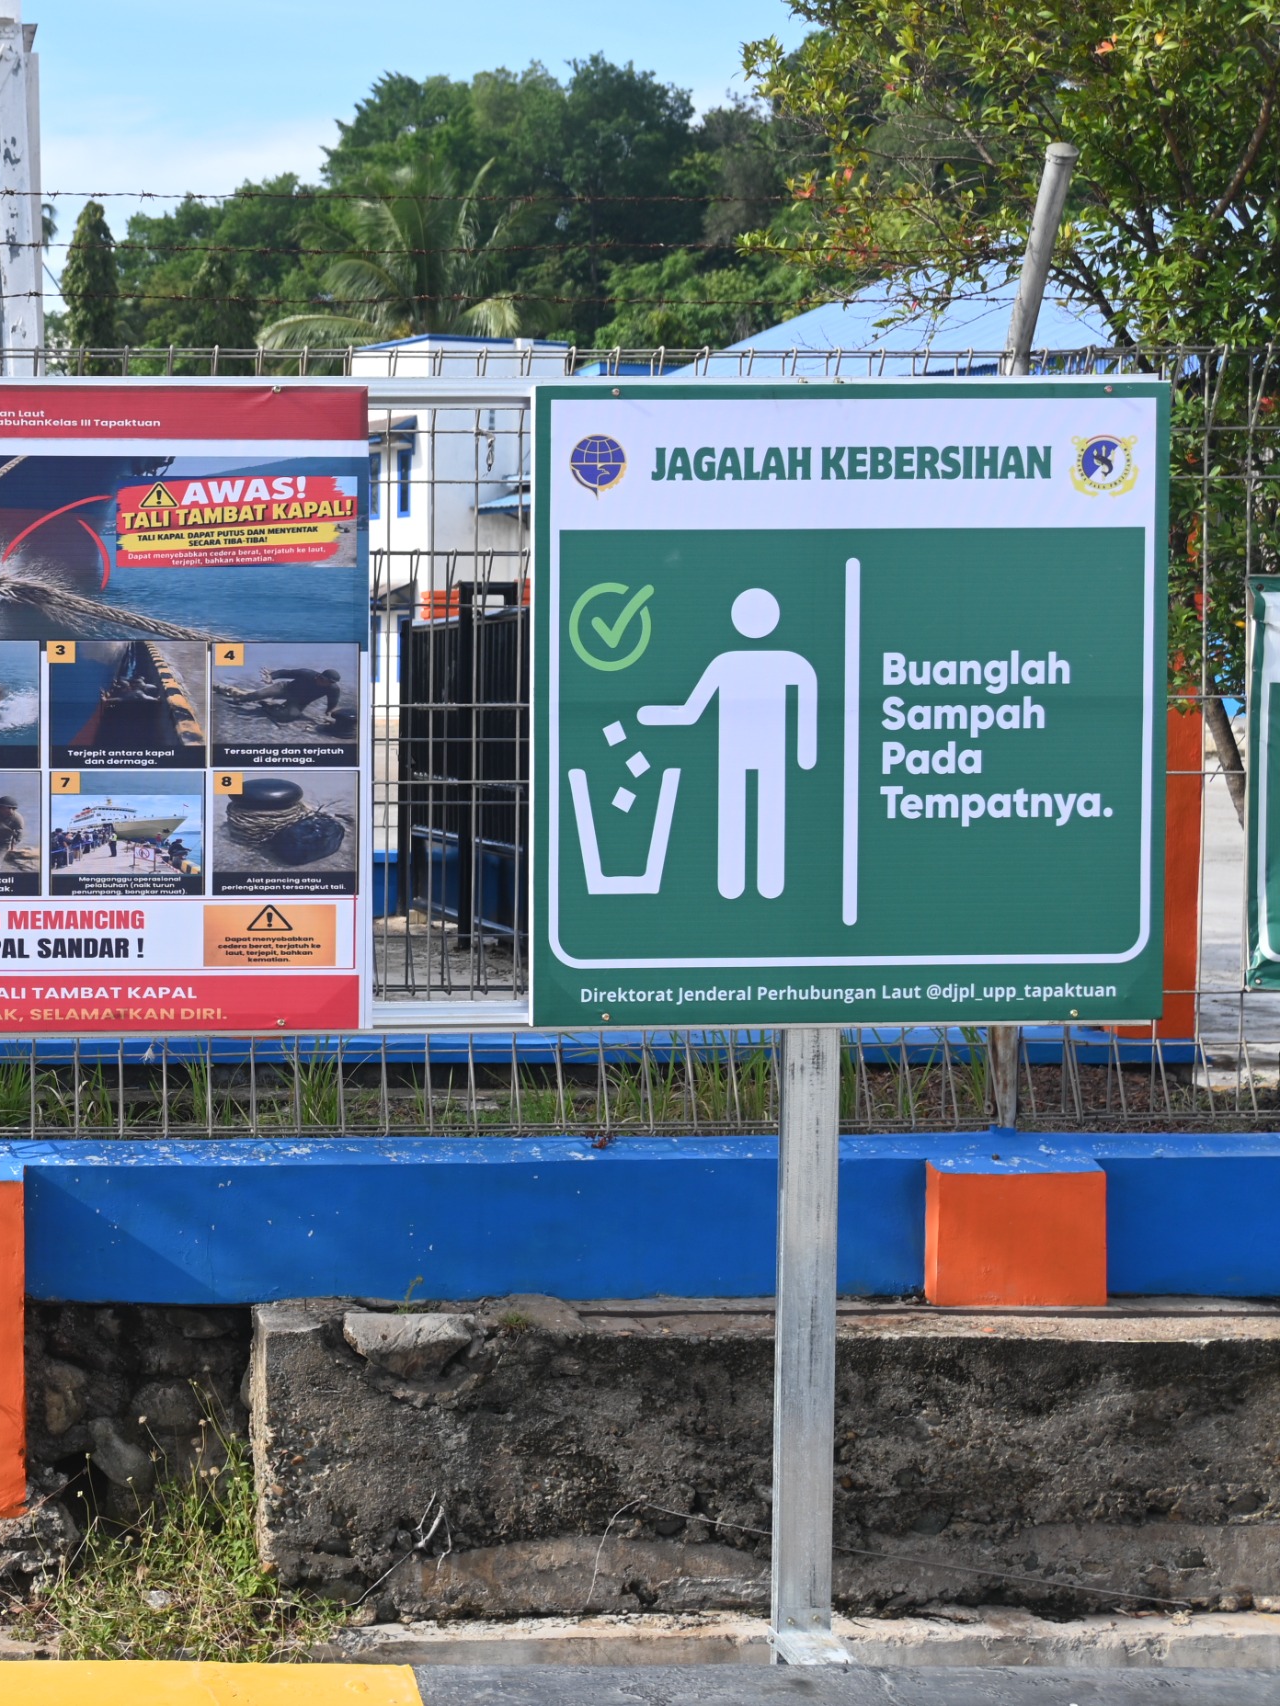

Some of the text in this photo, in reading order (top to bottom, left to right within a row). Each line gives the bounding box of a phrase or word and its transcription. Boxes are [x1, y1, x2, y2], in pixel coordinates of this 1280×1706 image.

[18, 410, 45, 418] Laut
[93, 419, 161, 429] Tapaktuan
[651, 446, 812, 481] JAGALAH
[820, 445, 1052, 480] KEBERSIHAN
[181, 476, 306, 506] AWAS!
[122, 499, 354, 529] TALI TAMBAT KAPAL!
[137, 526, 318, 542] TALI KAPAL DAPAT PUTUS DAN MENYENTAK
[188, 536, 268, 547] SECARA TIBA-TIBA!
[55, 645, 66, 656] 3
[224, 650, 236, 661] 4
[882, 650, 1071, 694] Buanglah
[881, 696, 1045, 738] Sampah
[67, 749, 107, 759] Terjepit
[148, 749, 174, 758] kapal
[280, 747, 301, 756] dan
[302, 747, 344, 757] terjatuh
[882, 741, 982, 775] Pada
[84, 757, 158, 767] dan dermaga.
[253, 755, 316, 765] di dermaga.
[60, 777, 71, 788] 7
[221, 776, 232, 787] 8
[880, 785, 1113, 827] Tempatnya.
[7, 910, 145, 930] MEMANCING
[37, 938, 129, 959] SANDAR
[31, 987, 122, 1000] TAMBAT
[127, 986, 198, 999] KAPAL
[580, 981, 1117, 1006] Direktorat Jenderal Perhubungan Laut @djpl_upp_tapaktuan
[30, 1008, 175, 1021] SELAMATKAN
[180, 1007, 228, 1020] DIRI.
